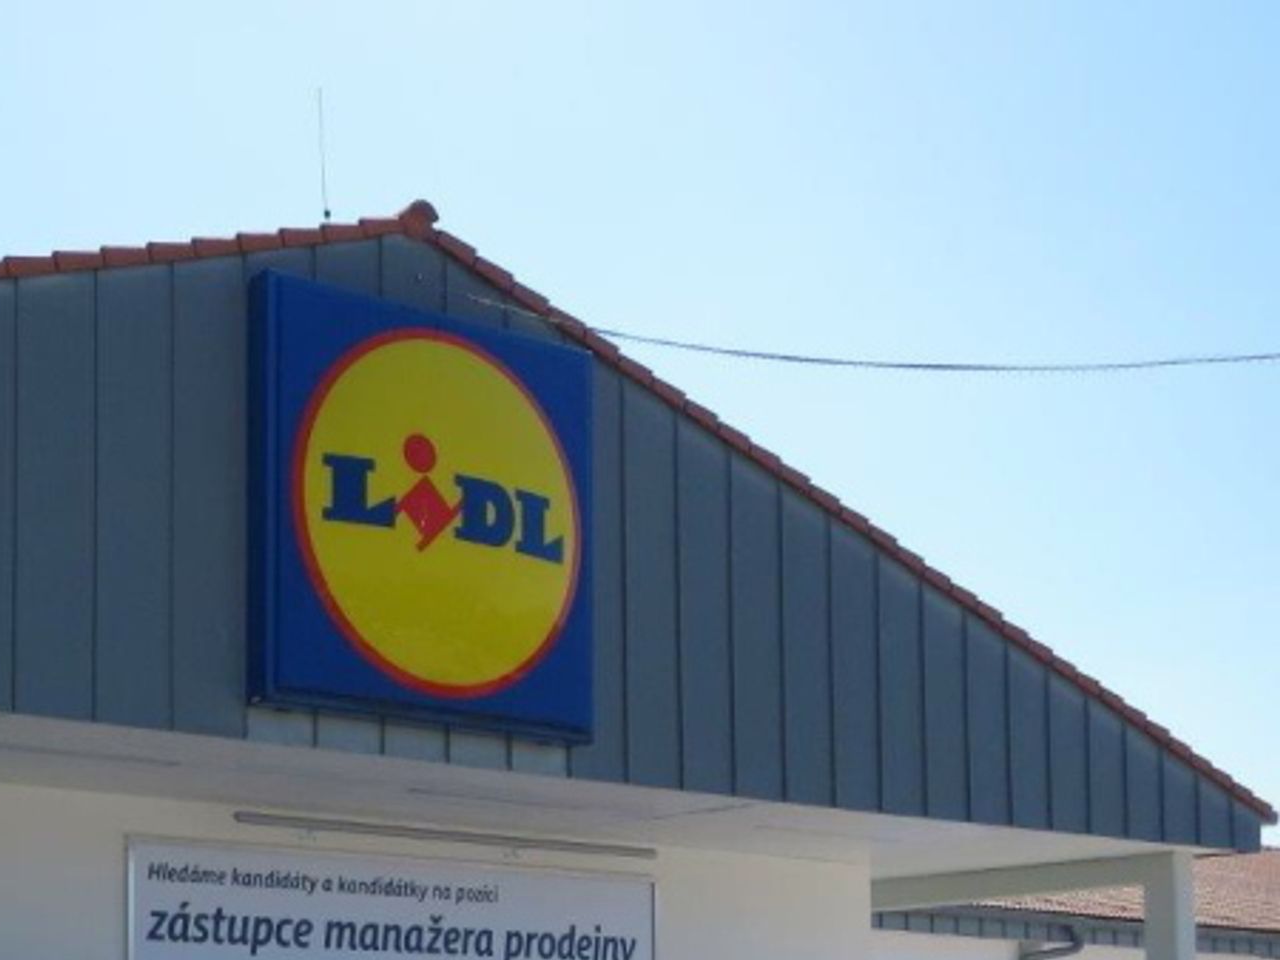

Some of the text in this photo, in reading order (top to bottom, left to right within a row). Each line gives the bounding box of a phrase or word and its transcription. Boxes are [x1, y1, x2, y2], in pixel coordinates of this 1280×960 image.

[147, 862, 226, 885] Hledáme
[230, 867, 318, 895] kandidáty
[321, 877, 333, 892] a
[338, 874, 428, 903] kandidátky
[146, 901, 314, 956] zástupce
[324, 914, 494, 957] manažera
